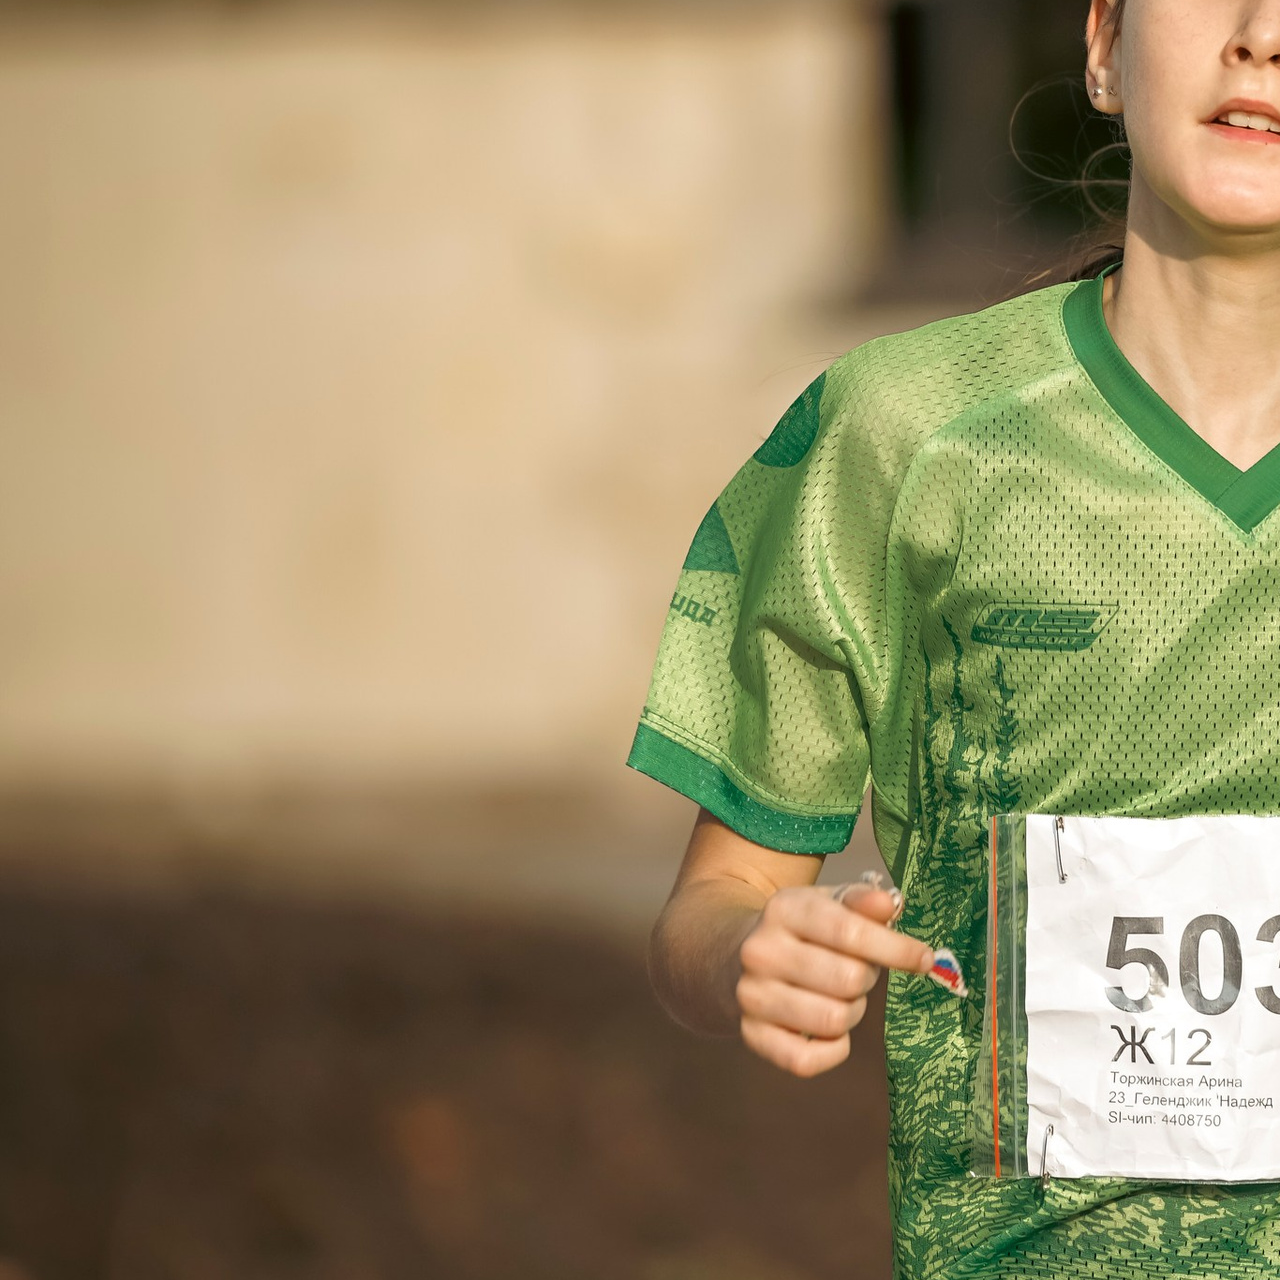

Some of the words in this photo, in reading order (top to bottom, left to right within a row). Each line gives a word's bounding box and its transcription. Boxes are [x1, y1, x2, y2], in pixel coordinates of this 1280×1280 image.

[980, 631, 1022, 643] MASS
[1024, 635, 1078, 645] SPORT
[1110, 1024, 1212, 1066] Ж12
[1110, 1071, 1194, 1088] Торжинская
[1198, 1075, 1243, 1090] Арина
[1108, 1090, 1212, 1108] 23_Геленджик
[1108, 1110, 1157, 1125] SI-чип:
[1161, 1113, 1222, 1127] 4408750
